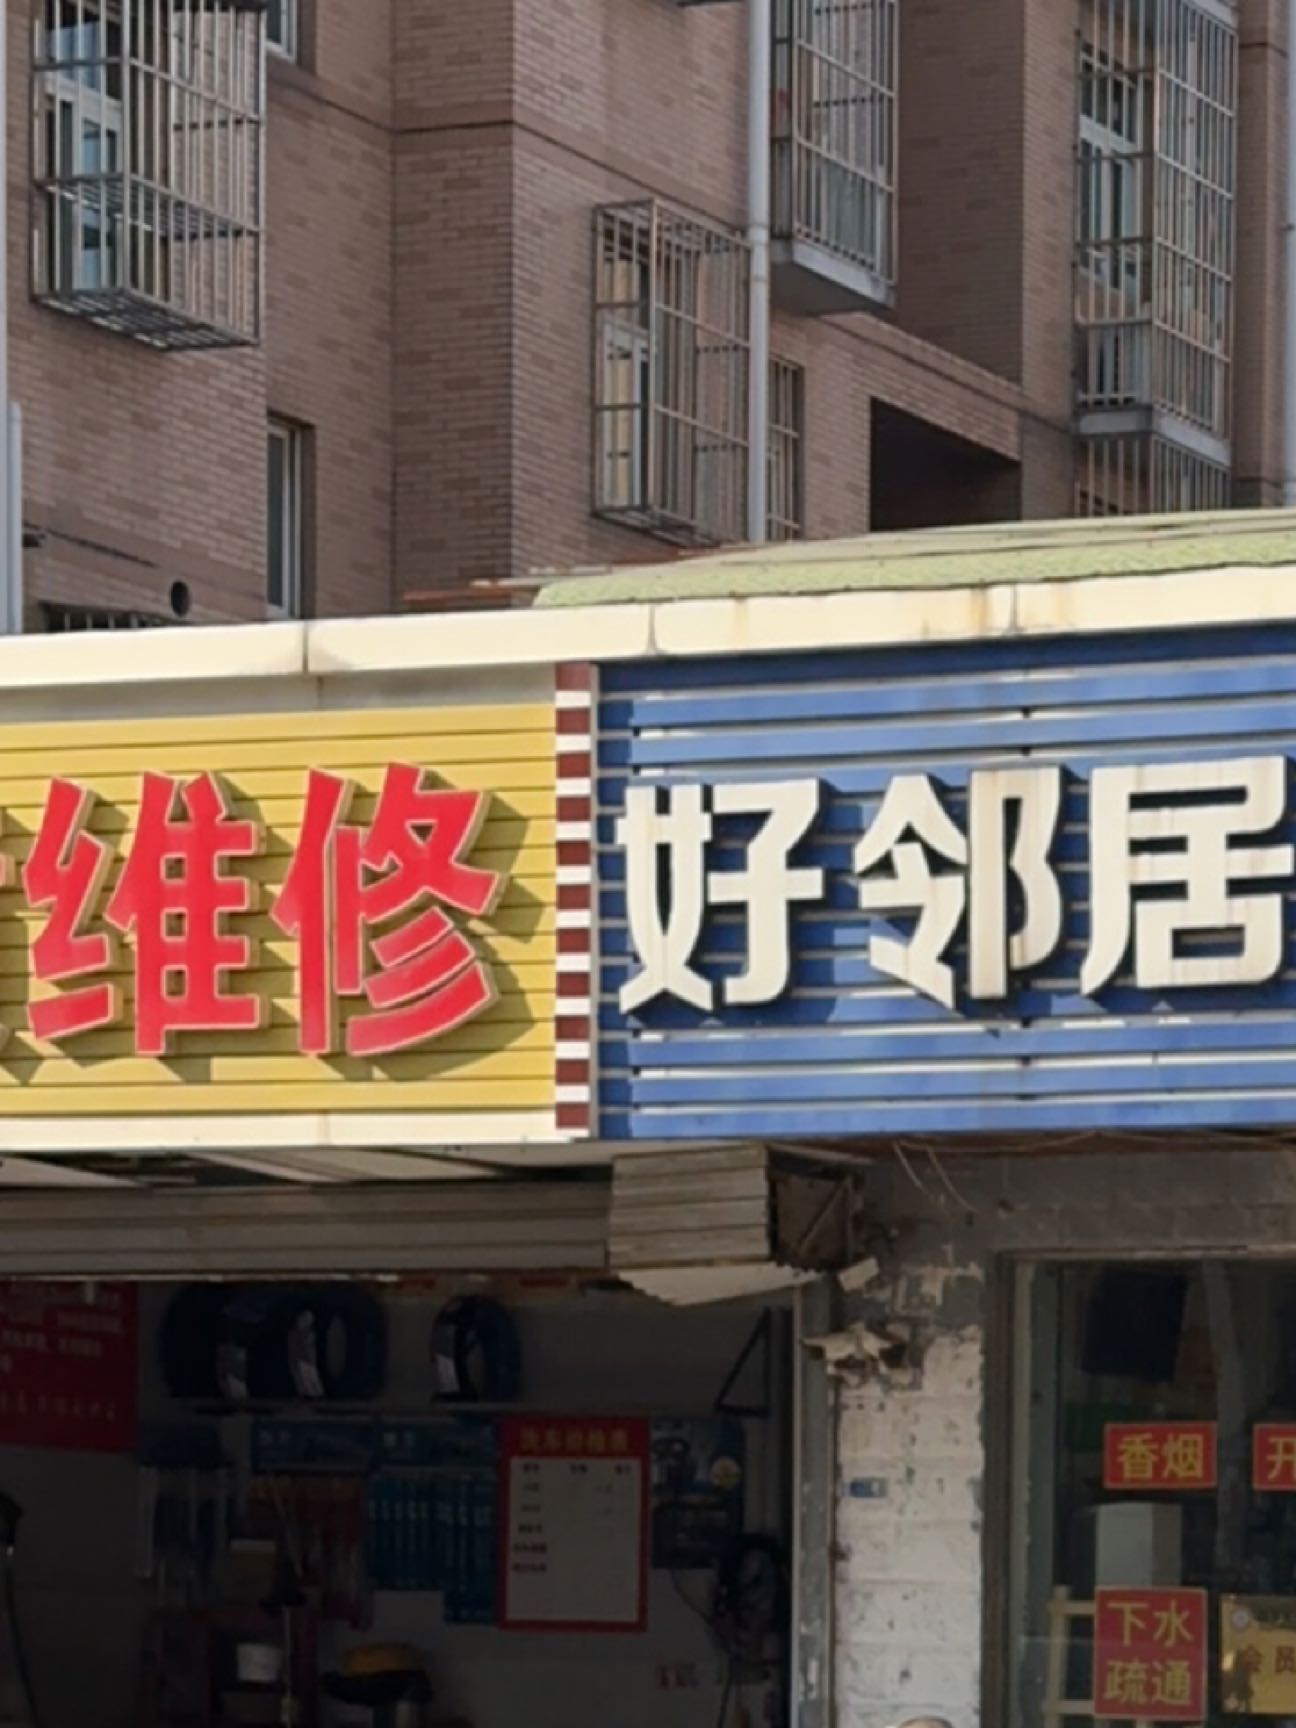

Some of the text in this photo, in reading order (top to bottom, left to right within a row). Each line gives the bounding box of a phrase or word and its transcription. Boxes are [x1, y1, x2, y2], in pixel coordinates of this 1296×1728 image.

[0, 760, 508, 1058] 维修
[1116, 1432, 1204, 1480] 香烟
[1106, 1600, 1194, 1648] 下水
[1103, 1658, 1193, 1708] 疏通
